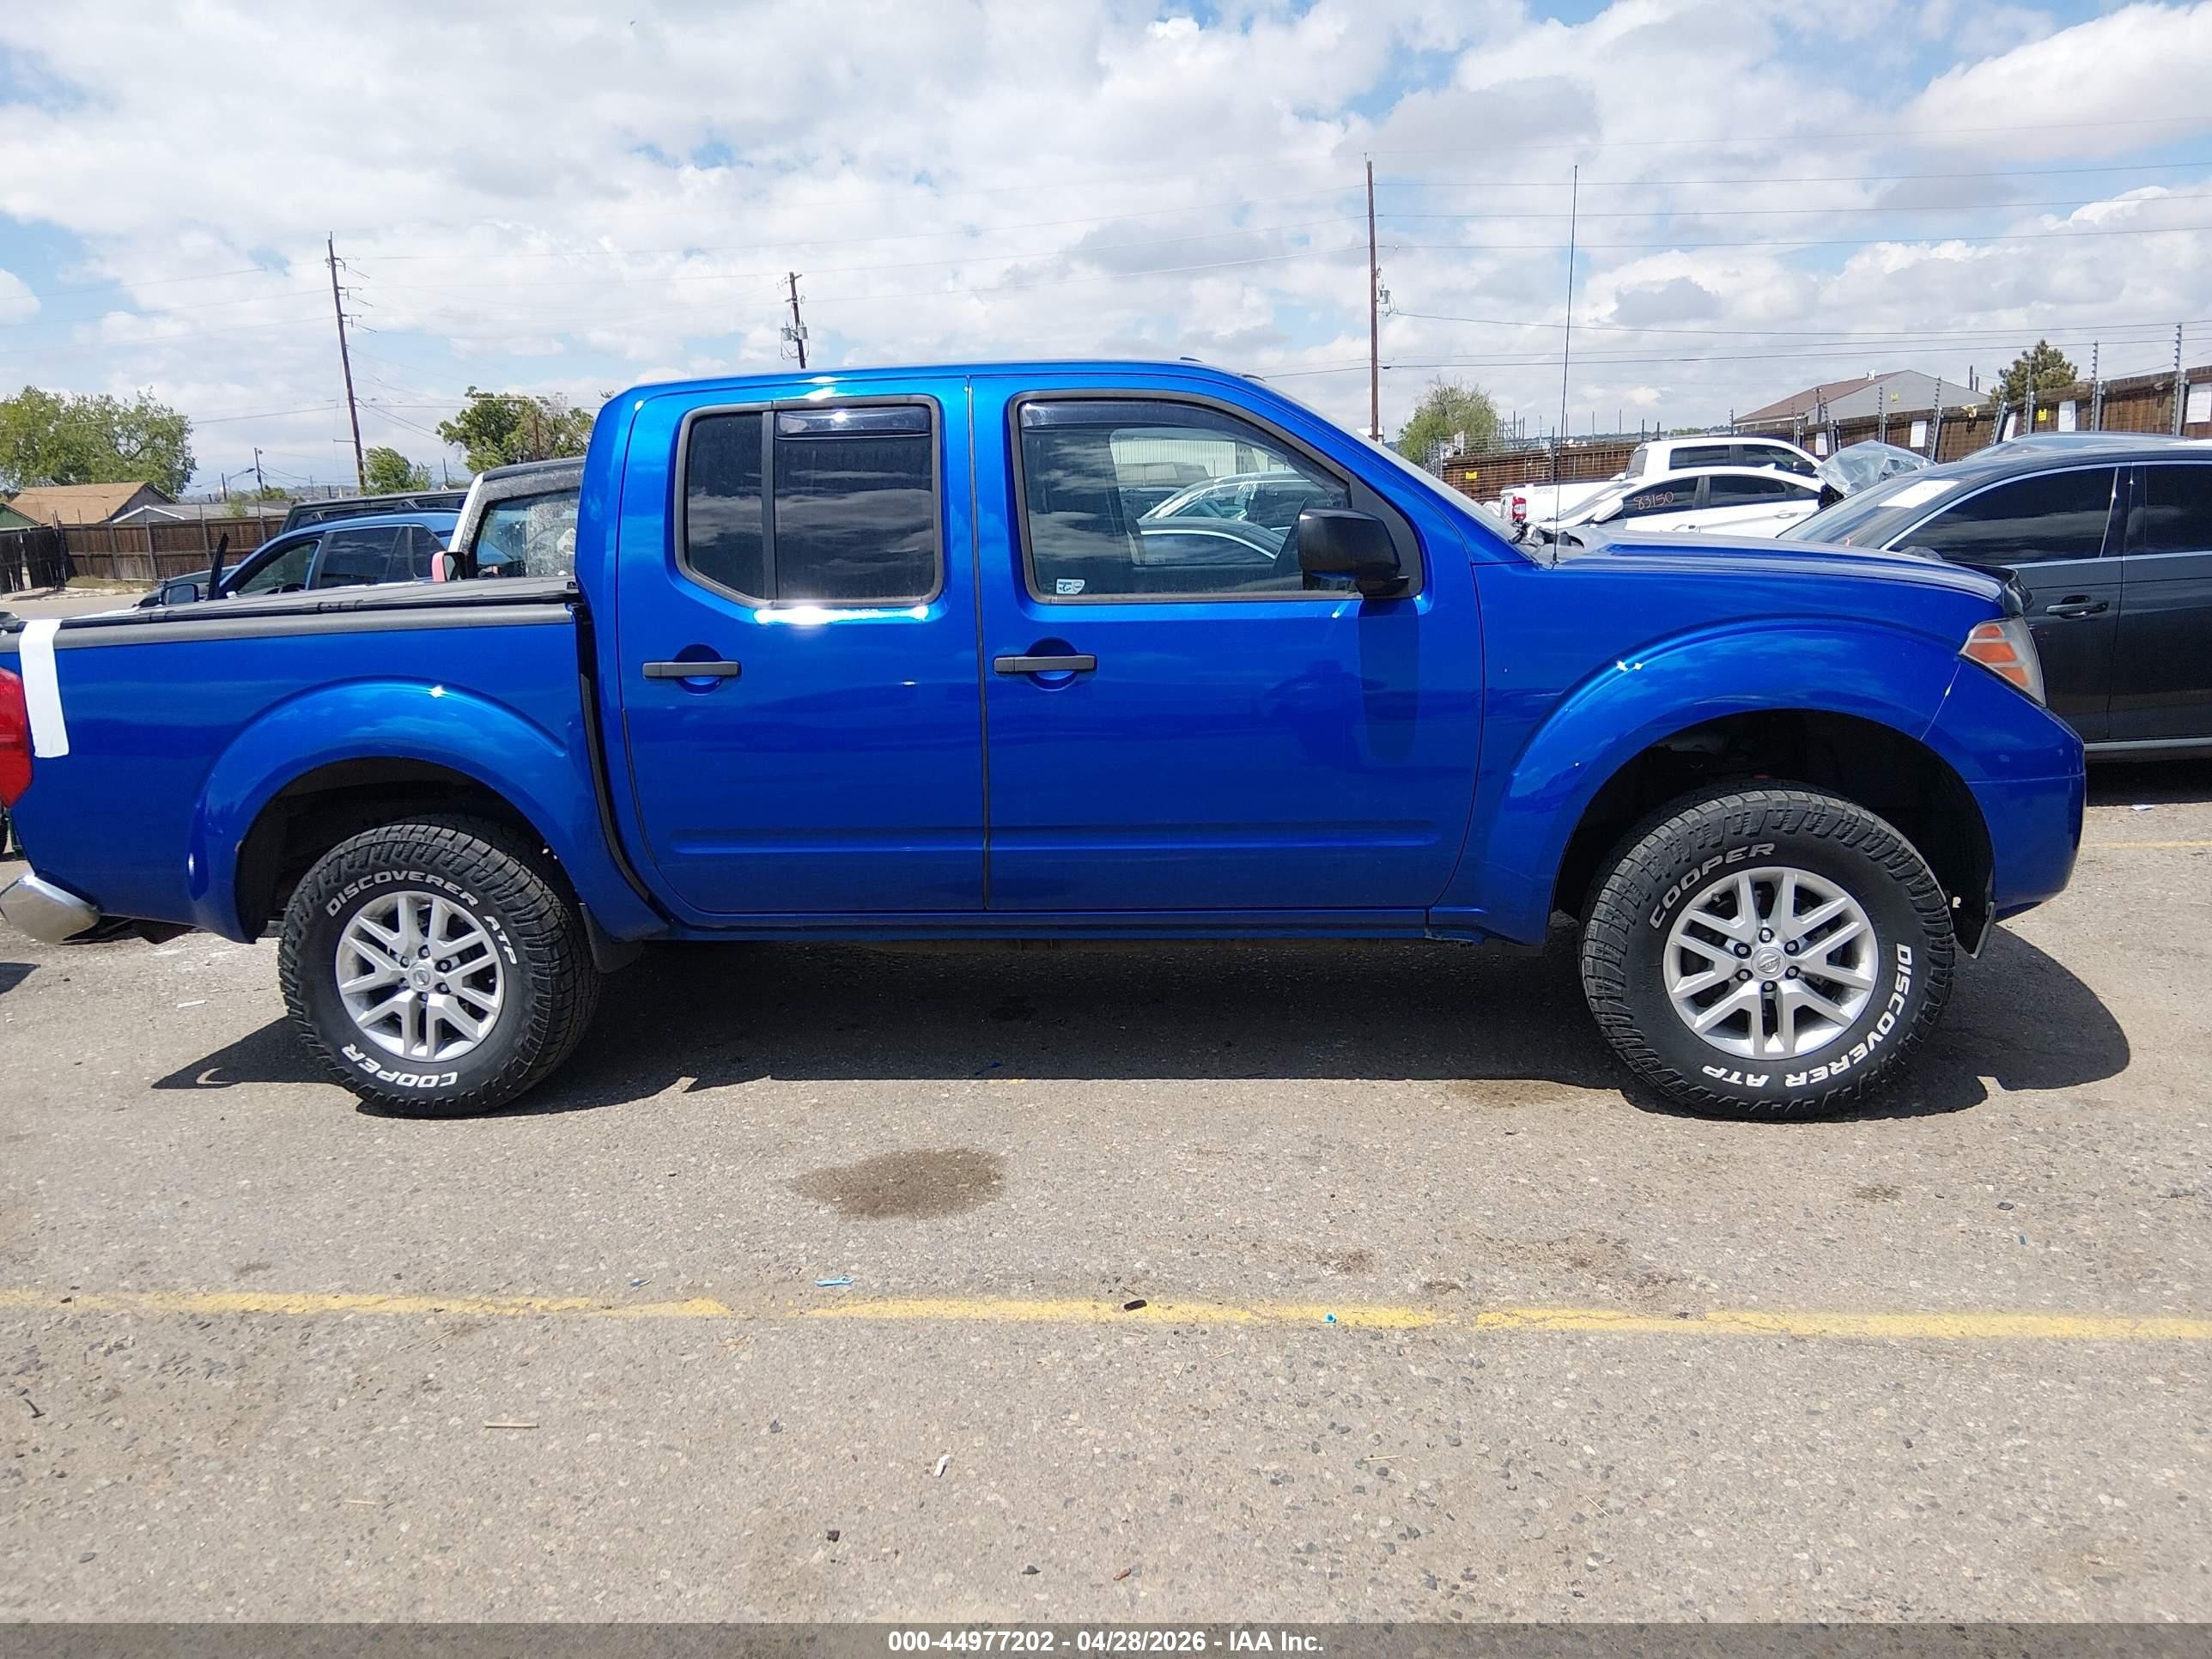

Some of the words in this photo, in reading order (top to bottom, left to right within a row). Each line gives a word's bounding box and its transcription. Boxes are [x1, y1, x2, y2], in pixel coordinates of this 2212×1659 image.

[1633, 491, 1674, 510] 83150
[326, 870, 478, 916] DISCOVERER
[483, 915, 518, 964] ATP
[1649, 842, 1776, 929] COOPER
[1784, 943, 1913, 1088] DISCOVERER
[342, 1042, 459, 1089] COOPER
[1702, 1065, 1770, 1087] ATP
